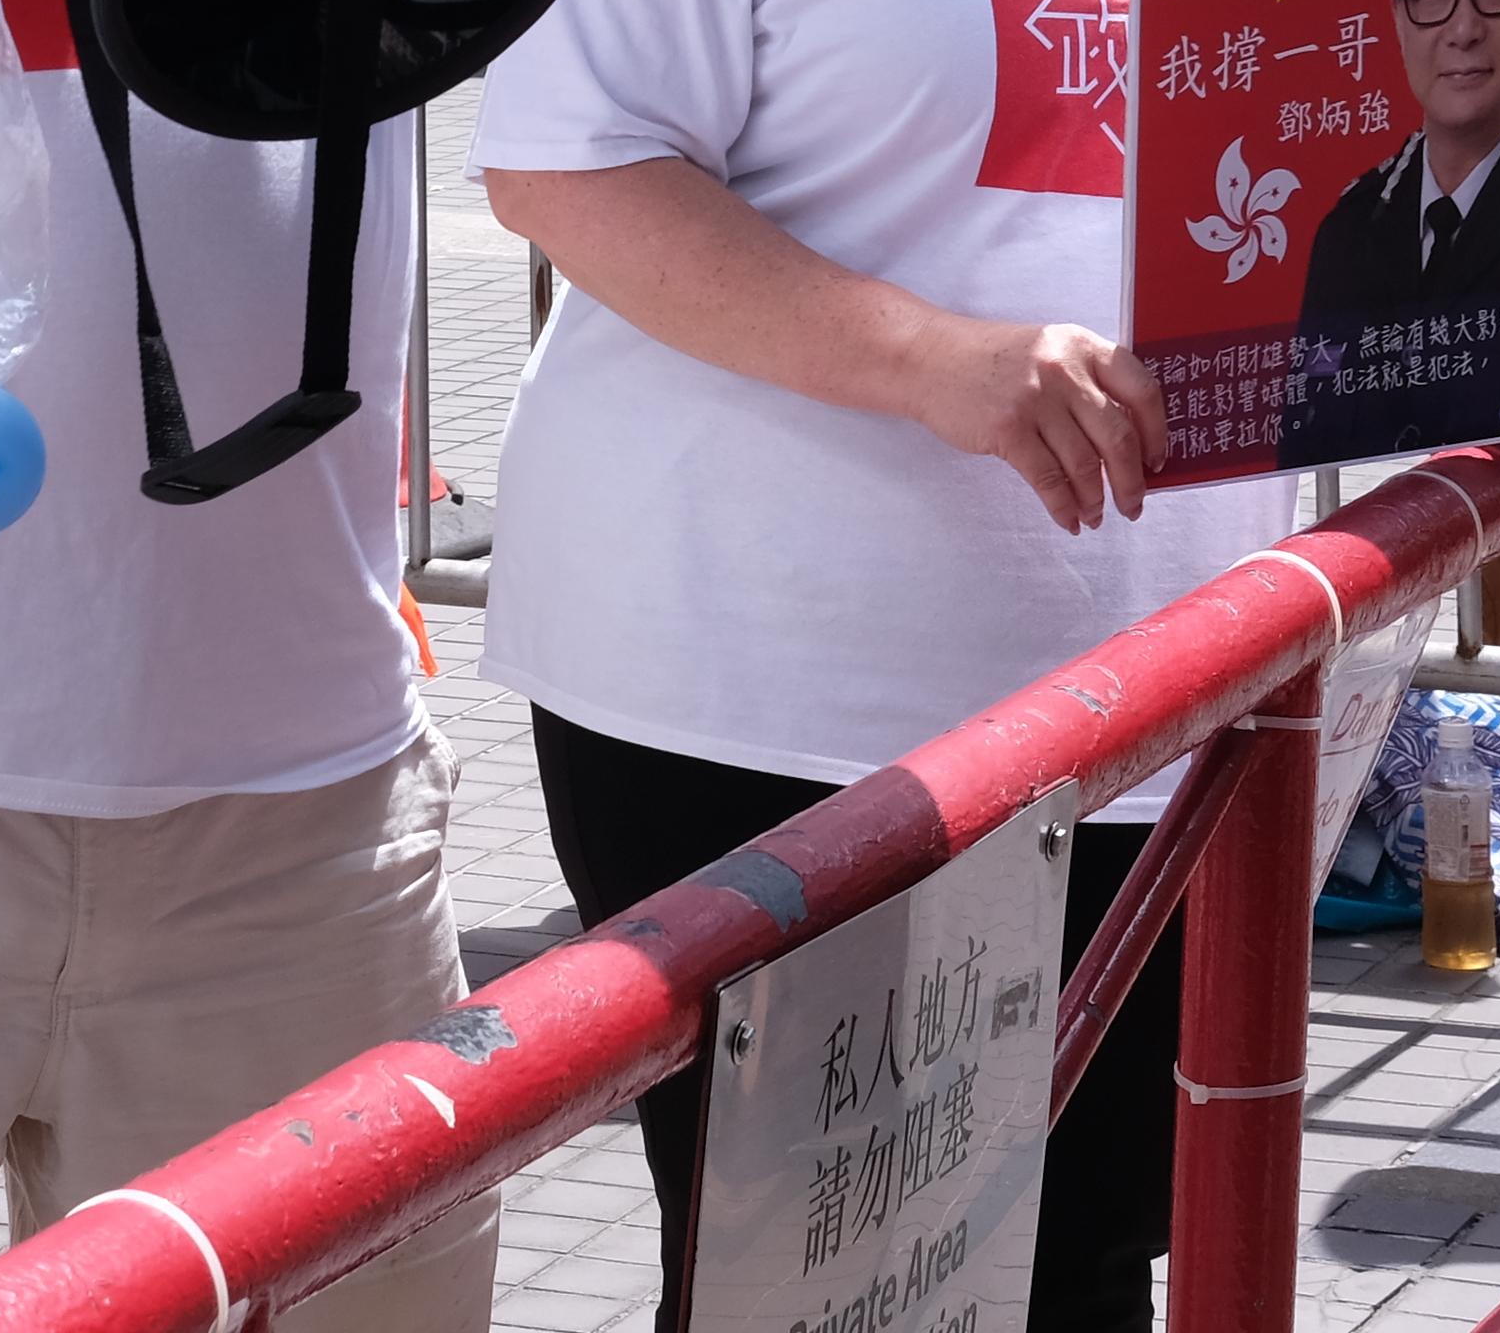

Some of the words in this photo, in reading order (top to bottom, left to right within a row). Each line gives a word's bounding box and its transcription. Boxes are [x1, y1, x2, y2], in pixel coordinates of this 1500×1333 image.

[1157, 13, 1378, 103] 我撐一哥
[1276, 95, 1392, 145] 鄧炳強
[815, 935, 987, 1133] 私人地方
[803, 1062, 980, 1278] 請勿阻塞
[901, 1220, 968, 1313] Area
